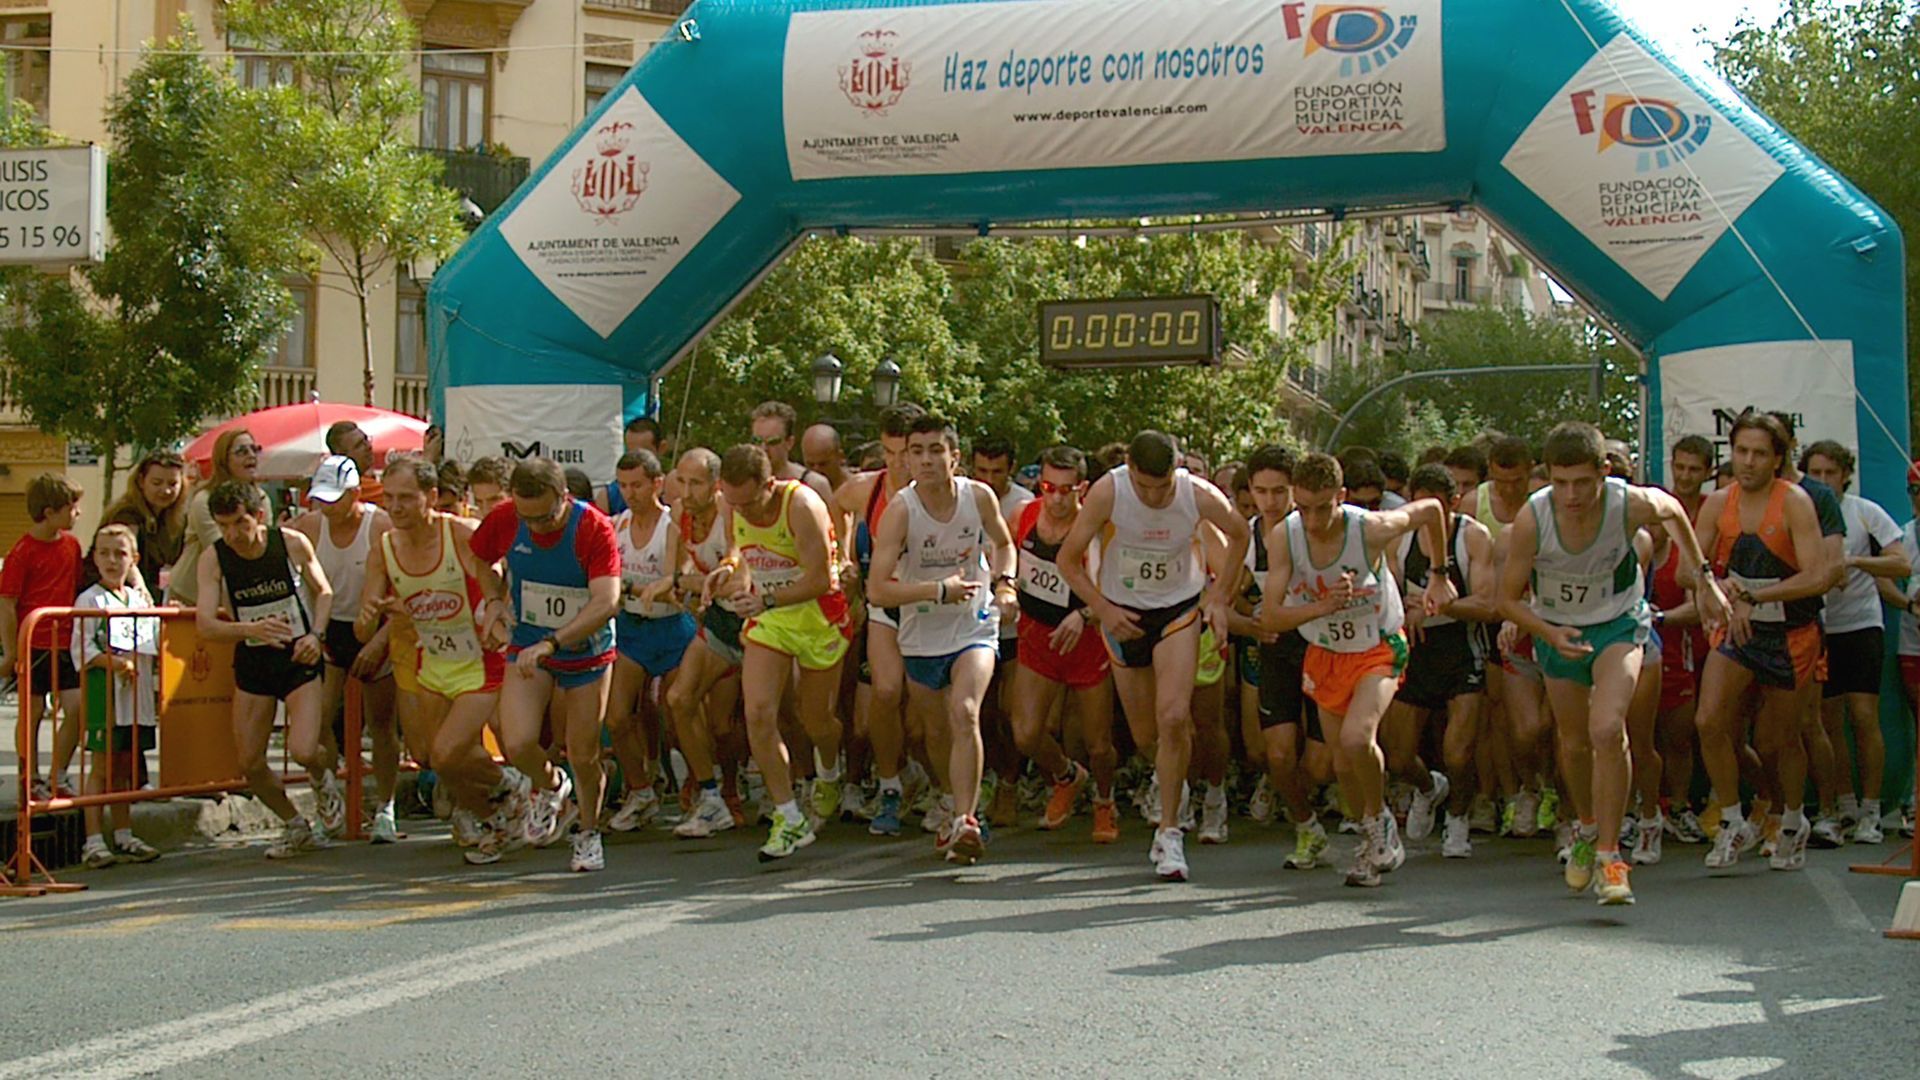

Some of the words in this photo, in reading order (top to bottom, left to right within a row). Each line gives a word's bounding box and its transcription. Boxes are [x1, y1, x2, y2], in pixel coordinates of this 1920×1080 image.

[943, 52, 988, 93] Haz
[998, 49, 1092, 95] deporte
[1101, 51, 1144, 84] con
[1154, 42, 1264, 80] nosotros
[1294, 81, 1402, 99] FUNDACIÓN
[1013, 102, 1208, 122] www.deportevalencia.com
[1295, 95, 1403, 112] DEPORTIVA
[1295, 109, 1403, 125] MUNICIPAL
[1297, 122, 1403, 135] VALENCIA
[803, 136, 879, 149] AJUNTAMENT
[883, 135, 899, 146] DE
[901, 133, 959, 145] VALENCIA
[0, 160, 48, 181] LISIS
[1599, 176, 1700, 193] FUNDACIÓN
[1600, 189, 1701, 206] DEPORTIVA
[1601, 201, 1702, 217] MUNICIPAL
[1604, 213, 1702, 227] VALENCIA
[21, 226, 45, 248] 15
[53, 225, 81, 247] 96
[528, 238, 599, 250] AJUNTAMENT
[602, 238, 619, 249] DE
[621, 236, 680, 247] VALENCIA
[1031, 567, 1059, 593] 202
[1140, 562, 1167, 580] 65
[234, 579, 288, 600] evasión
[1561, 584, 1588, 604] 57
[546, 597, 565, 617] 10
[1327, 621, 1355, 641] 58
[433, 634, 457, 651] 24
